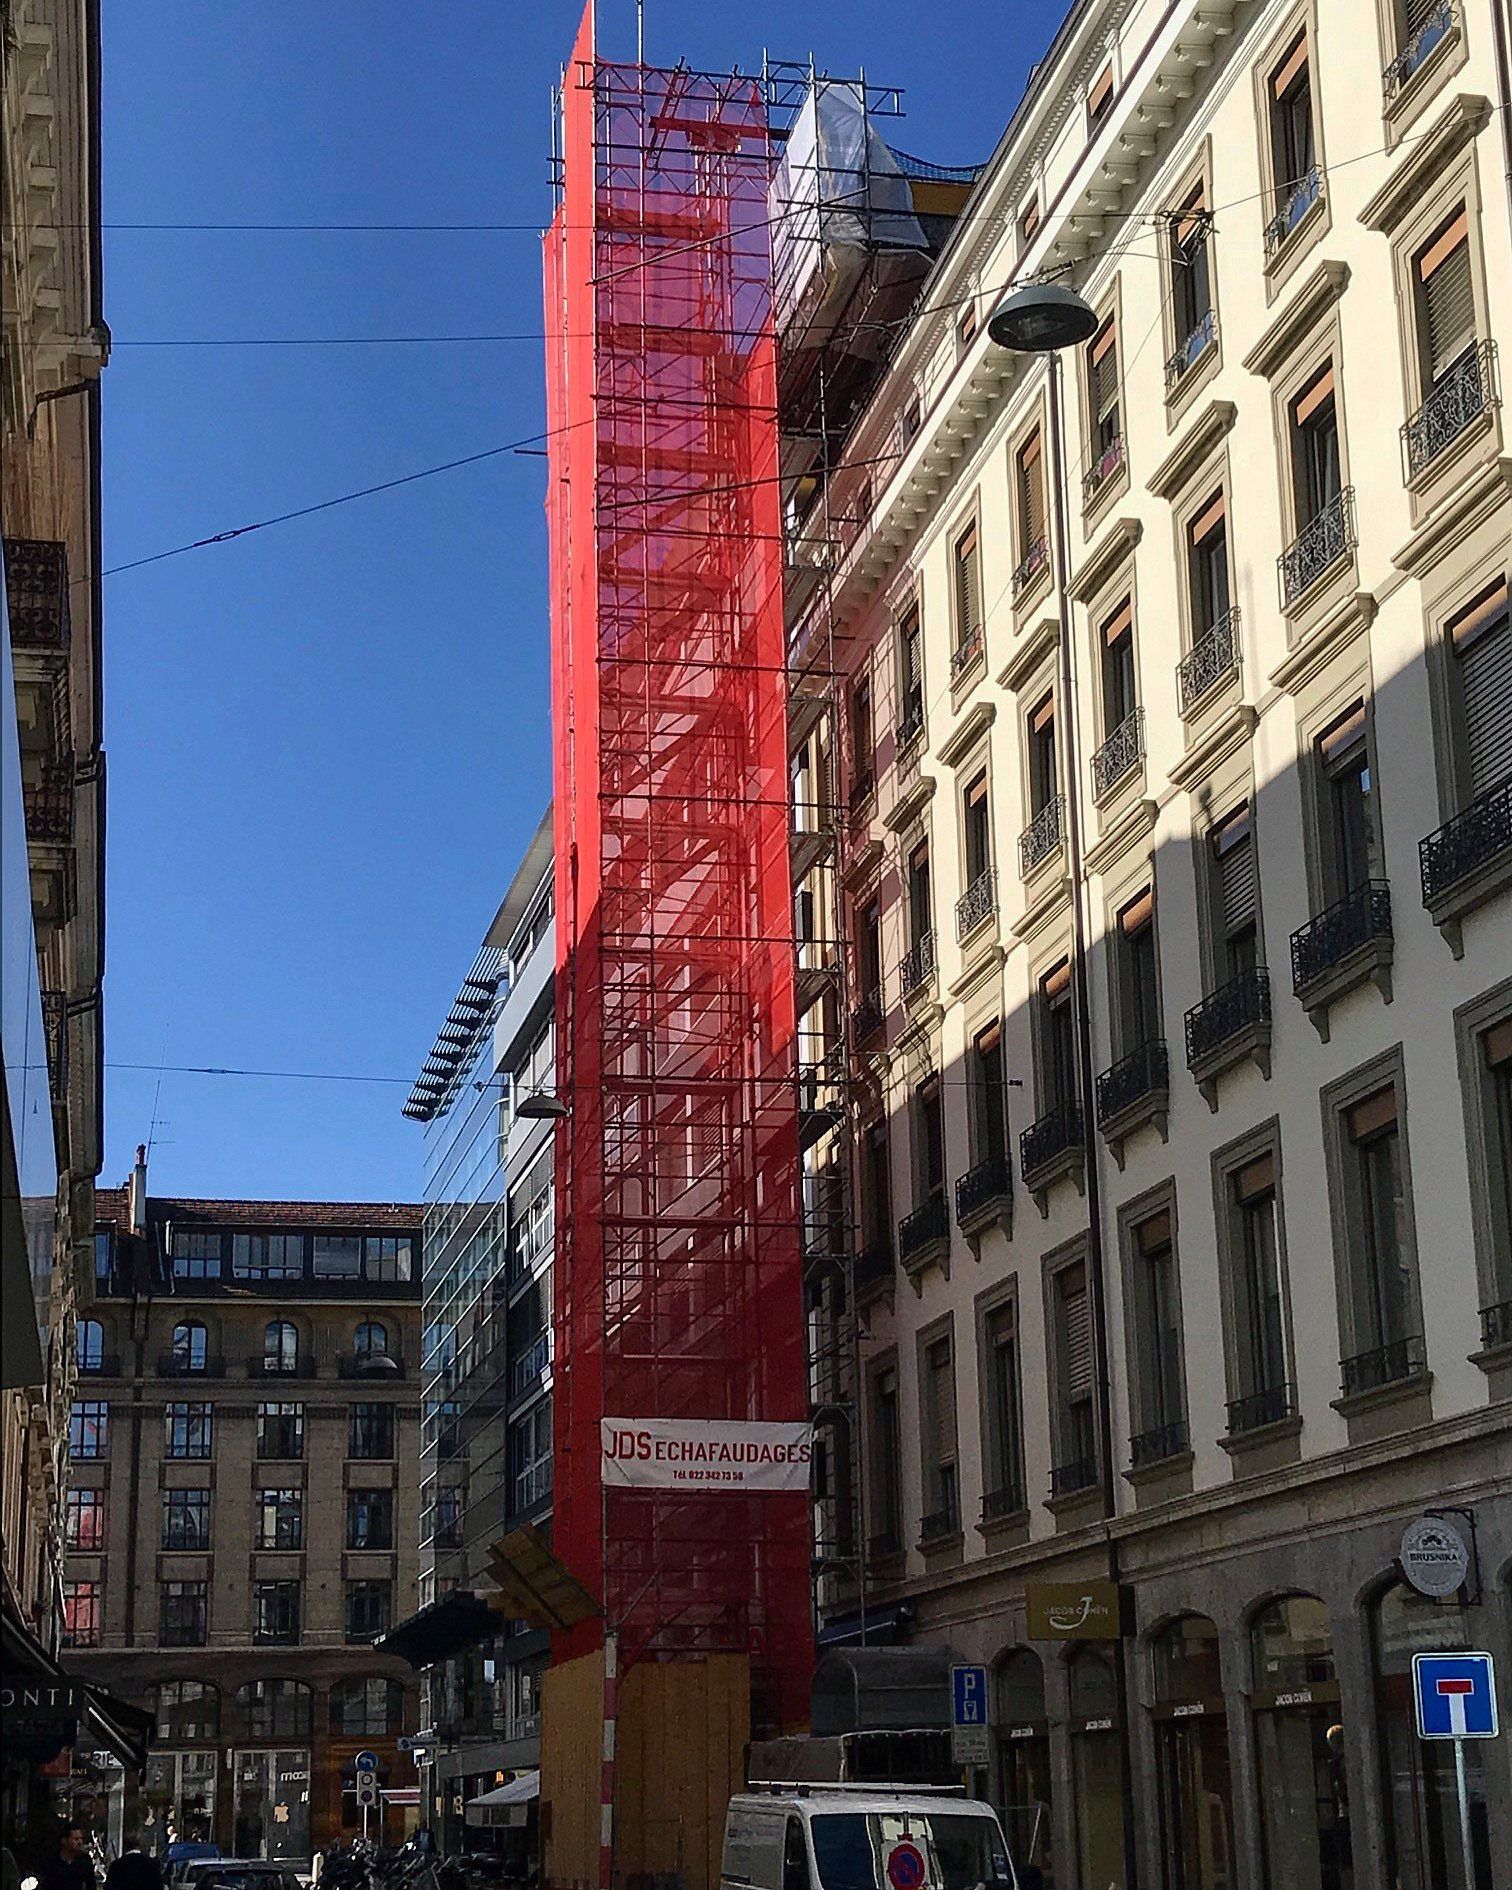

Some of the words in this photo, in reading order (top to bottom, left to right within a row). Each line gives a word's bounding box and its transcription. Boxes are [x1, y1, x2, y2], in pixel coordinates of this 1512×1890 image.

[605, 1431, 652, 1460] JDS
[655, 1442, 811, 1463] ECHAFAUDAGES
[689, 1471, 704, 1479] 022
[1409, 1552, 1458, 1562] BRUSNIKA
[964, 1673, 976, 1699] P
